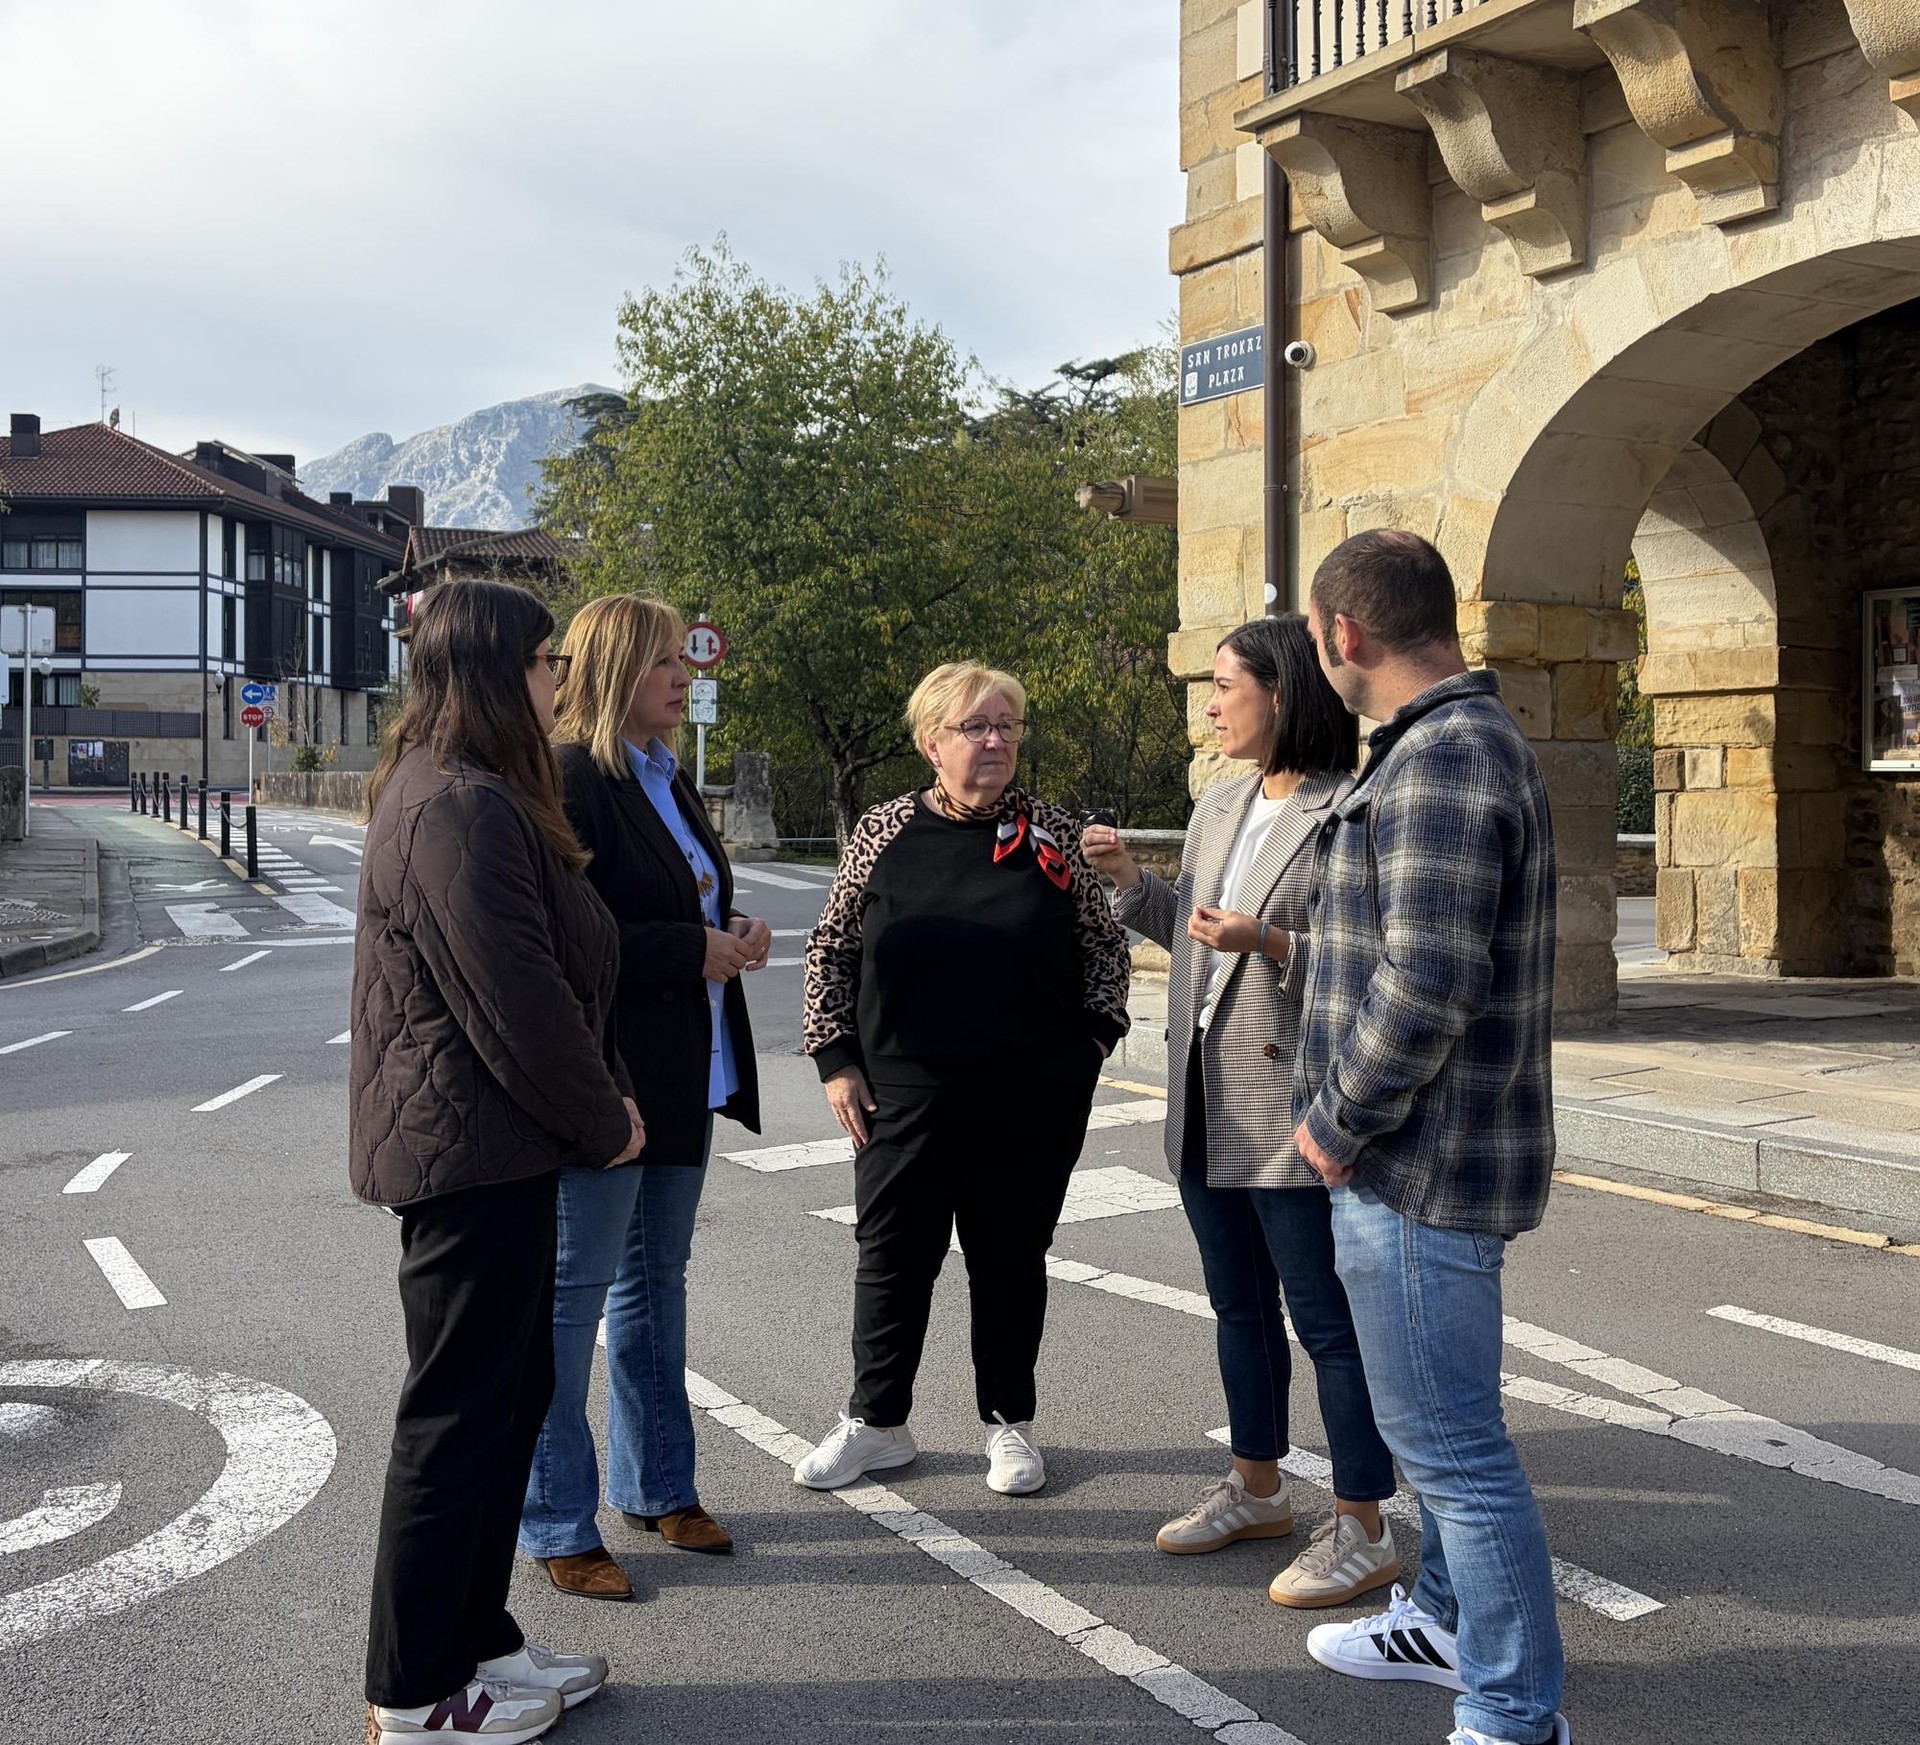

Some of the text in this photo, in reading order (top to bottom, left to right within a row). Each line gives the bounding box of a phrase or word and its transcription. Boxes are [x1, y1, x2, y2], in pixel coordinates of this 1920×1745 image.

[1187, 335, 1262, 368] SAN TROKAZ
[1208, 366, 1244, 388] PLAZA
[242, 713, 263, 721] STOP
